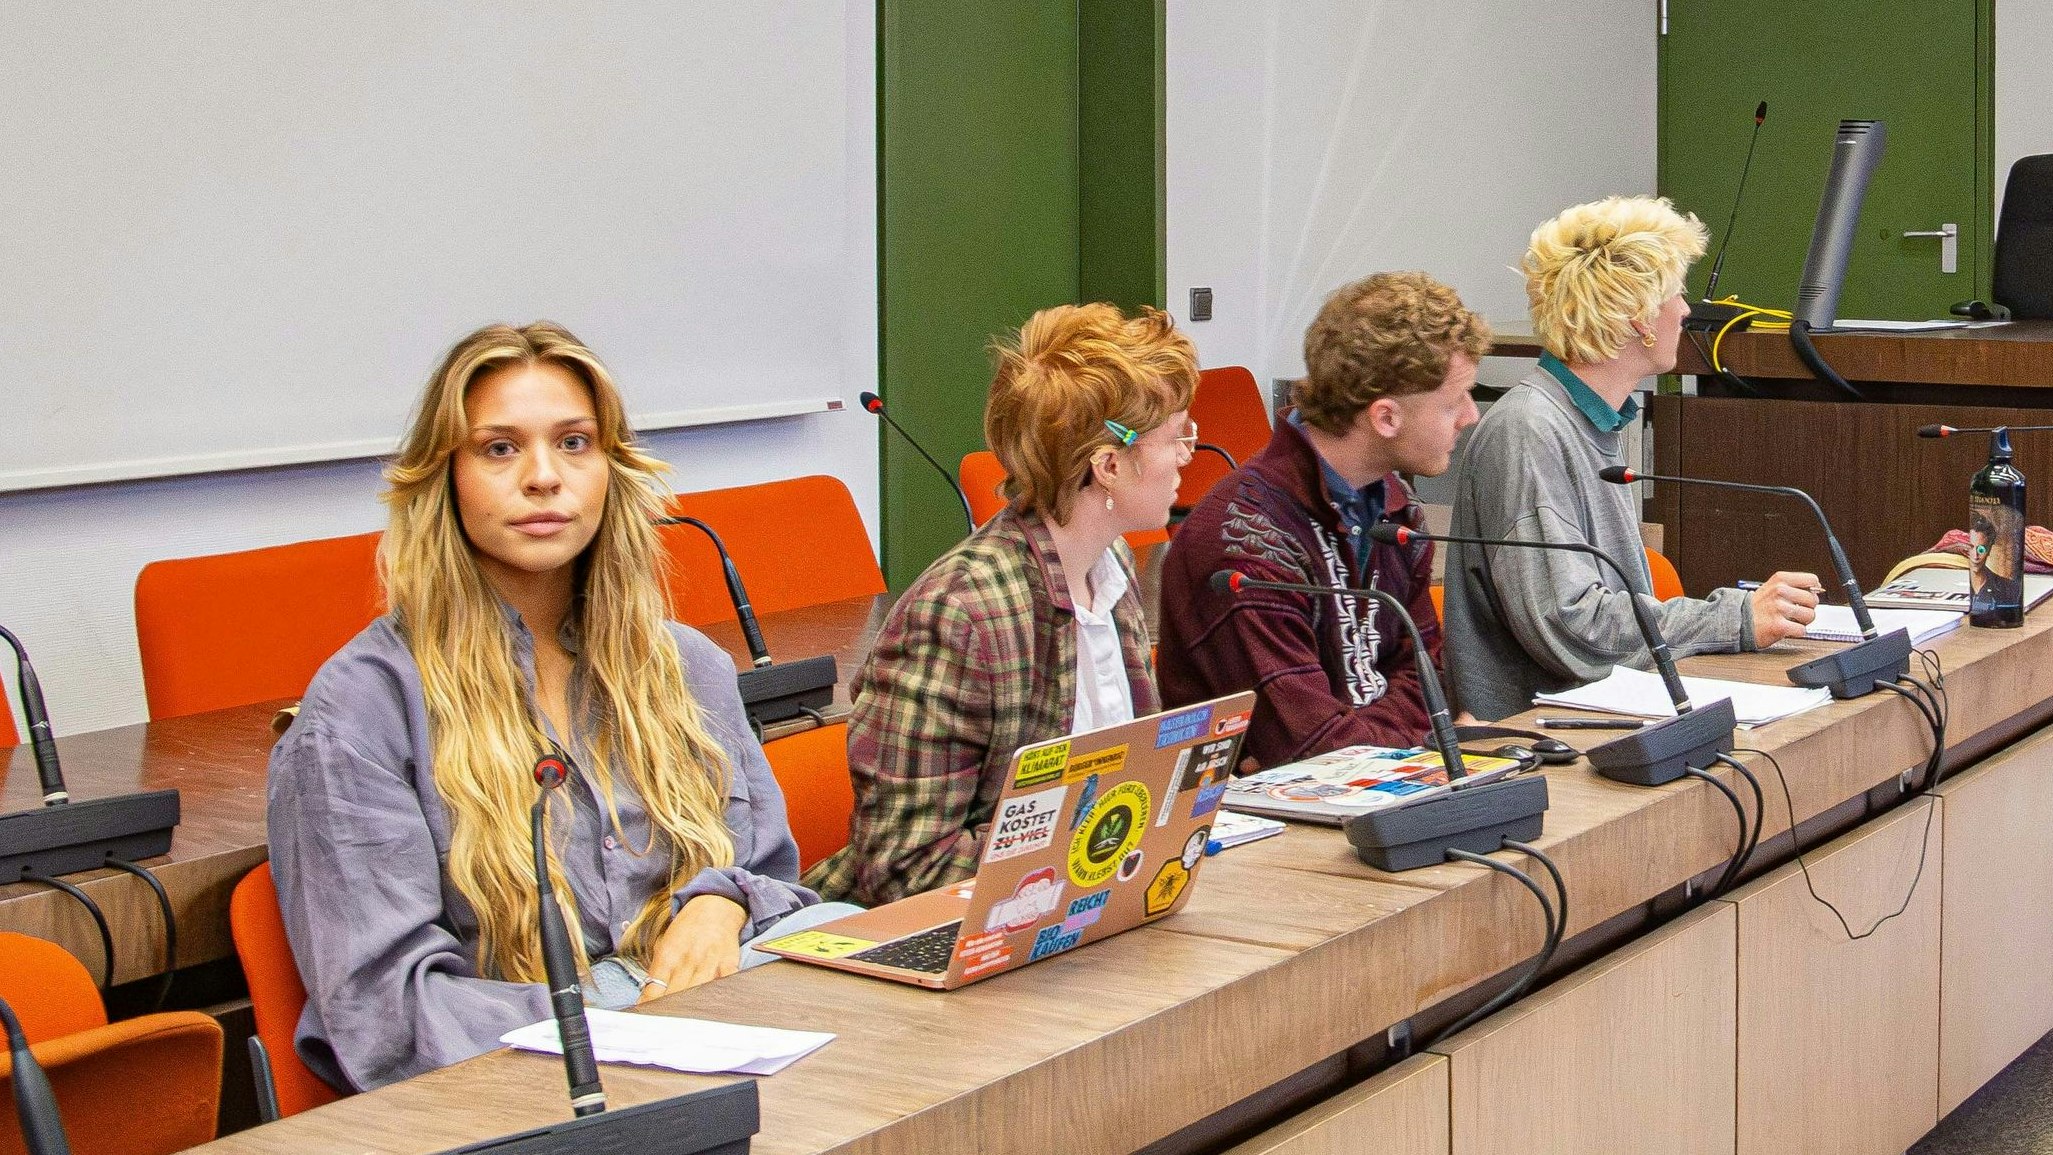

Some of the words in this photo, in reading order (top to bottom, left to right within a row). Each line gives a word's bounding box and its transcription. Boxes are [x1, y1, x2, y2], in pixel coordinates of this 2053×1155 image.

[1005, 800, 1036, 818] GAS
[999, 810, 1057, 835] KOSTET
[993, 836, 1014, 851] ZU
[1020, 826, 1050, 843] VIEL
[1067, 889, 1111, 916] REICHT
[1029, 930, 1082, 961] KAUFEN
[1037, 925, 1061, 945] BIO
